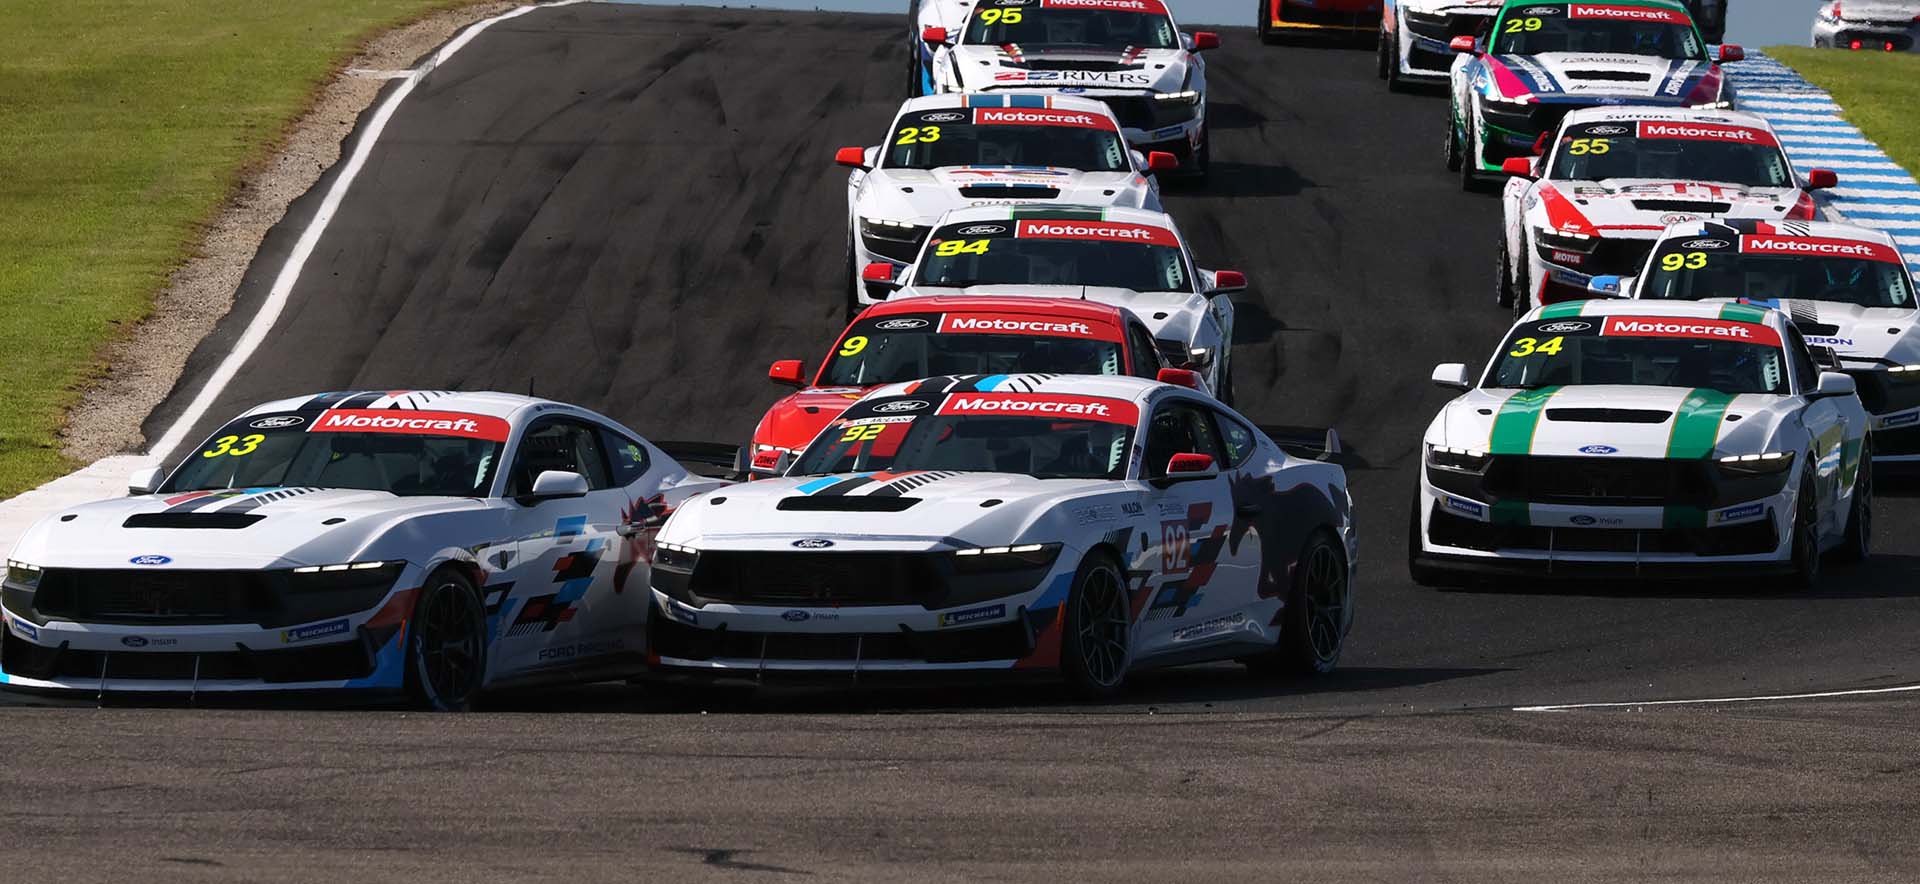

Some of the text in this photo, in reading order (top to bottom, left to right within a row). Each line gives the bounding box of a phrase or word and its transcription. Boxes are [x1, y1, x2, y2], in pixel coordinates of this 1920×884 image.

[1049, 0, 1145, 9] Motorcraft
[980, 7, 1023, 26] 95
[1576, 7, 1671, 20] Motorcraft
[1504, 18, 1543, 33] 29
[1063, 71, 1150, 84] RIVERS
[983, 111, 1093, 125] Motorcraft
[1605, 112, 1673, 120] Suttons
[895, 126, 941, 145] 23
[1646, 125, 1752, 141] Motorcraft
[1569, 139, 1610, 155] 55
[1027, 223, 1151, 240] Motorcraft
[936, 239, 990, 256] 94
[1751, 239, 1873, 256] Motorcraft
[1661, 252, 1708, 271] 93
[951, 317, 1088, 335] Motorcraft
[1613, 321, 1749, 338] Motorcraft
[839, 336, 869, 357] 9
[1510, 336, 1564, 357] 34
[1804, 337, 1853, 346] BBON
[953, 399, 1108, 417] Motorcraft
[325, 414, 475, 432] Motorcraft
[839, 424, 886, 442] 92
[203, 434, 265, 458] 33
[1164, 524, 1187, 570] 92
[300, 622, 345, 638] MICHELIN
[538, 645, 578, 661] FORD
